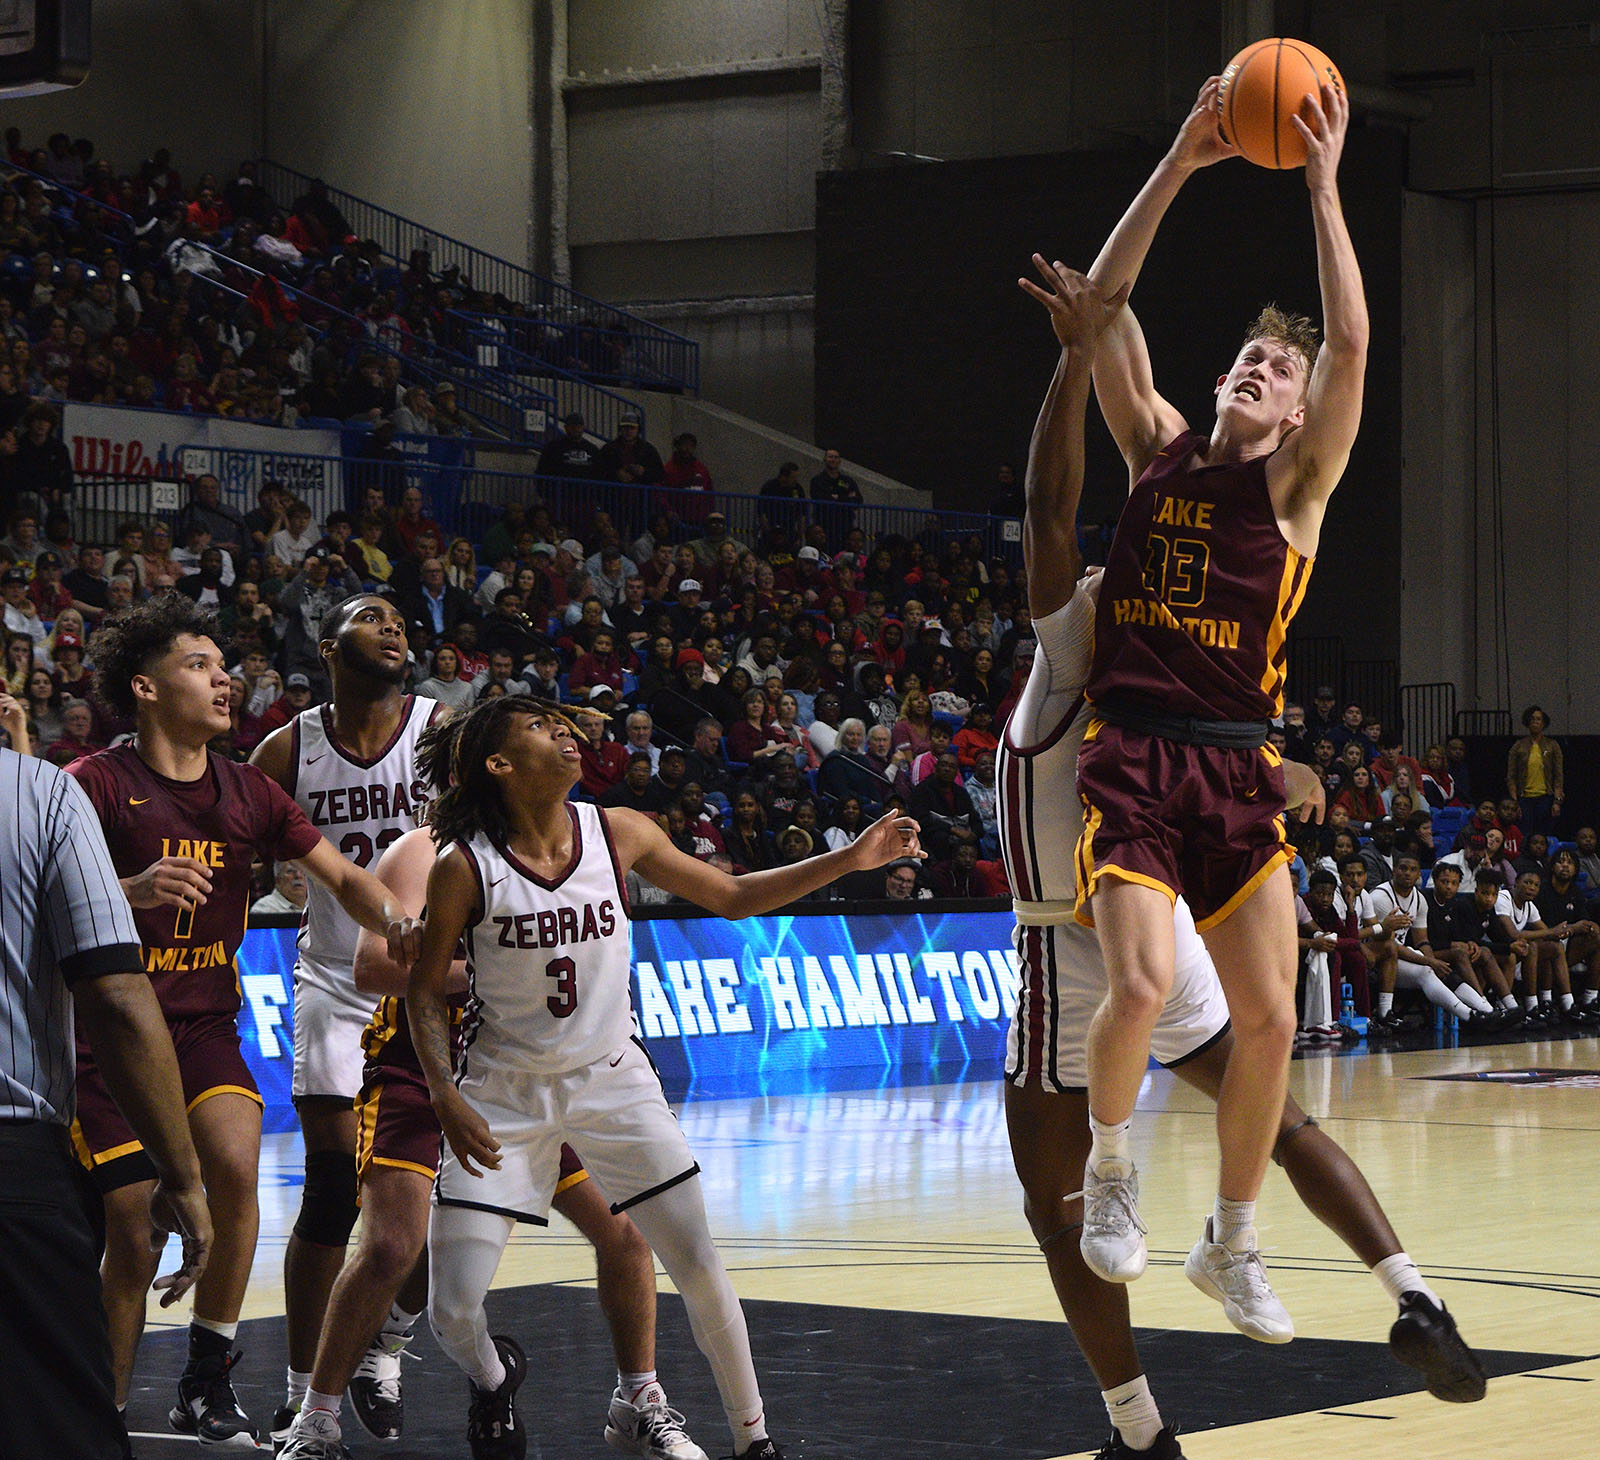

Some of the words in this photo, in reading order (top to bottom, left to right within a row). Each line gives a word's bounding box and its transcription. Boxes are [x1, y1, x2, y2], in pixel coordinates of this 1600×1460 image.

[156, 487, 176, 504] 213
[1112, 598, 1241, 650] HAMTON
[308, 780, 430, 827] ZEBRAS
[161, 838, 228, 868] LAKE
[493, 899, 616, 950] ZEBRAS
[139, 940, 228, 973] MILTON
[545, 955, 578, 1019] 3
[636, 958, 754, 1038] AKE
[760, 949, 1019, 1033] HAMILTON
